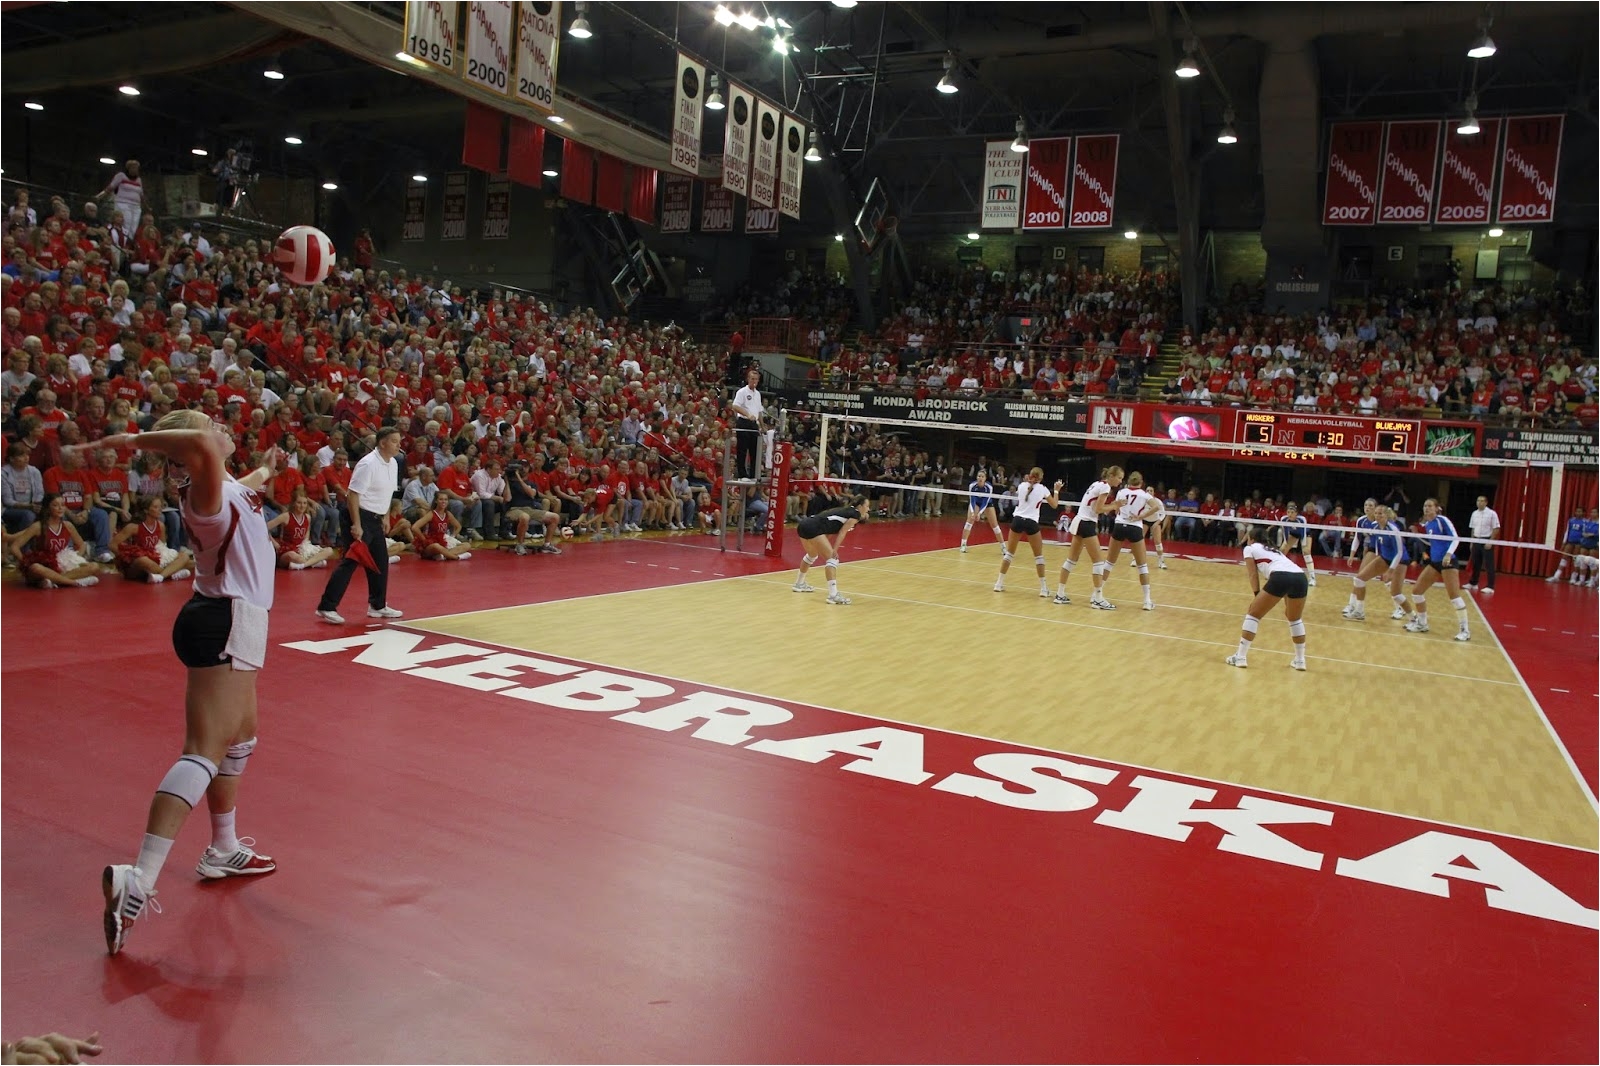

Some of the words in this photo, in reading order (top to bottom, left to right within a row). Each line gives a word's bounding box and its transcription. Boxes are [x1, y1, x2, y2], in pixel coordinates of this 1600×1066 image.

[470, 1, 508, 72] CHAMPION
[410, 35, 452, 67] 1995
[520, 25, 554, 84] CHAMPION
[468, 59, 506, 88] 2000
[519, 78, 552, 104] 2006
[681, 98, 697, 119] FINAL
[680, 117, 695, 134] FOUR
[732, 125, 746, 144] FINAL
[731, 141, 744, 160] FOUR
[759, 139, 773, 158] FINAL
[674, 148, 697, 169] 1996
[759, 156, 772, 172] FOUR
[986, 160, 1021, 168] MATCH
[726, 170, 746, 190] 1990
[994, 170, 1020, 178] CLUB
[1330, 153, 1375, 204] CHAMPION
[1386, 152, 1431, 203] CHAMPION
[1444, 150, 1491, 202] CHAMPION
[1506, 148, 1553, 201] CHAMPION
[754, 183, 773, 202] 1989
[1028, 165, 1065, 209] CHAMPION
[1075, 163, 1112, 208] CHAMPION
[780, 195, 800, 214] 1986
[1382, 205, 1426, 219] 2006
[1441, 205, 1486, 219] 2005
[1502, 203, 1548, 218] 2004
[662, 209, 690, 230] 2003
[703, 208, 732, 229] 2004
[746, 208, 778, 229] 2007
[1028, 211, 1060, 223] 2010
[1073, 211, 1108, 223] 2008
[1328, 206, 1370, 220] 2007
[1055, 248, 1064, 258] D
[1391, 248, 1401, 259] E
[1275, 281, 1320, 293] COLISEUM
[872, 396, 914, 408] HONDA
[917, 398, 988, 412] BRODERICK
[1004, 402, 1027, 411] ALLISON
[1026, 403, 1050, 412] WESTON
[1050, 405, 1065, 413] 1995
[907, 409, 952, 421] AWARD
[1029, 412, 1049, 420] PAVAN
[1048, 413, 1065, 421] 2006
[1075, 413, 1087, 424] N
[1104, 408, 1123, 425] N
[1246, 413, 1275, 423] HUSKERS
[1287, 417, 1322, 426] NEBRASKA
[1322, 419, 1364, 428] VOLLEYBALL
[1173, 420, 1200, 440] N
[1260, 426, 1269, 442] 5
[1375, 421, 1412, 431] BLUEJAYS
[1278, 430, 1295, 445] N
[1318, 432, 1344, 446] 1:30
[1352, 434, 1371, 450] N
[1392, 435, 1404, 451] 2
[1485, 438, 1500, 450] N
[1543, 432, 1578, 443] KANOUSE
[1502, 440, 1536, 450] CHRISTY
[1535, 442, 1571, 452] JOHNSON
[1517, 451, 1548, 460] JORDAN
[1548, 453, 1581, 465] LARSON
[1125, 494, 1138, 506] 17
[764, 467, 781, 551] NEBRASKA
[293, 526, 306, 538] N
[50, 538, 66, 550] N
[145, 535, 159, 548] N
[278, 628, 1599, 930] NEBRASKA
